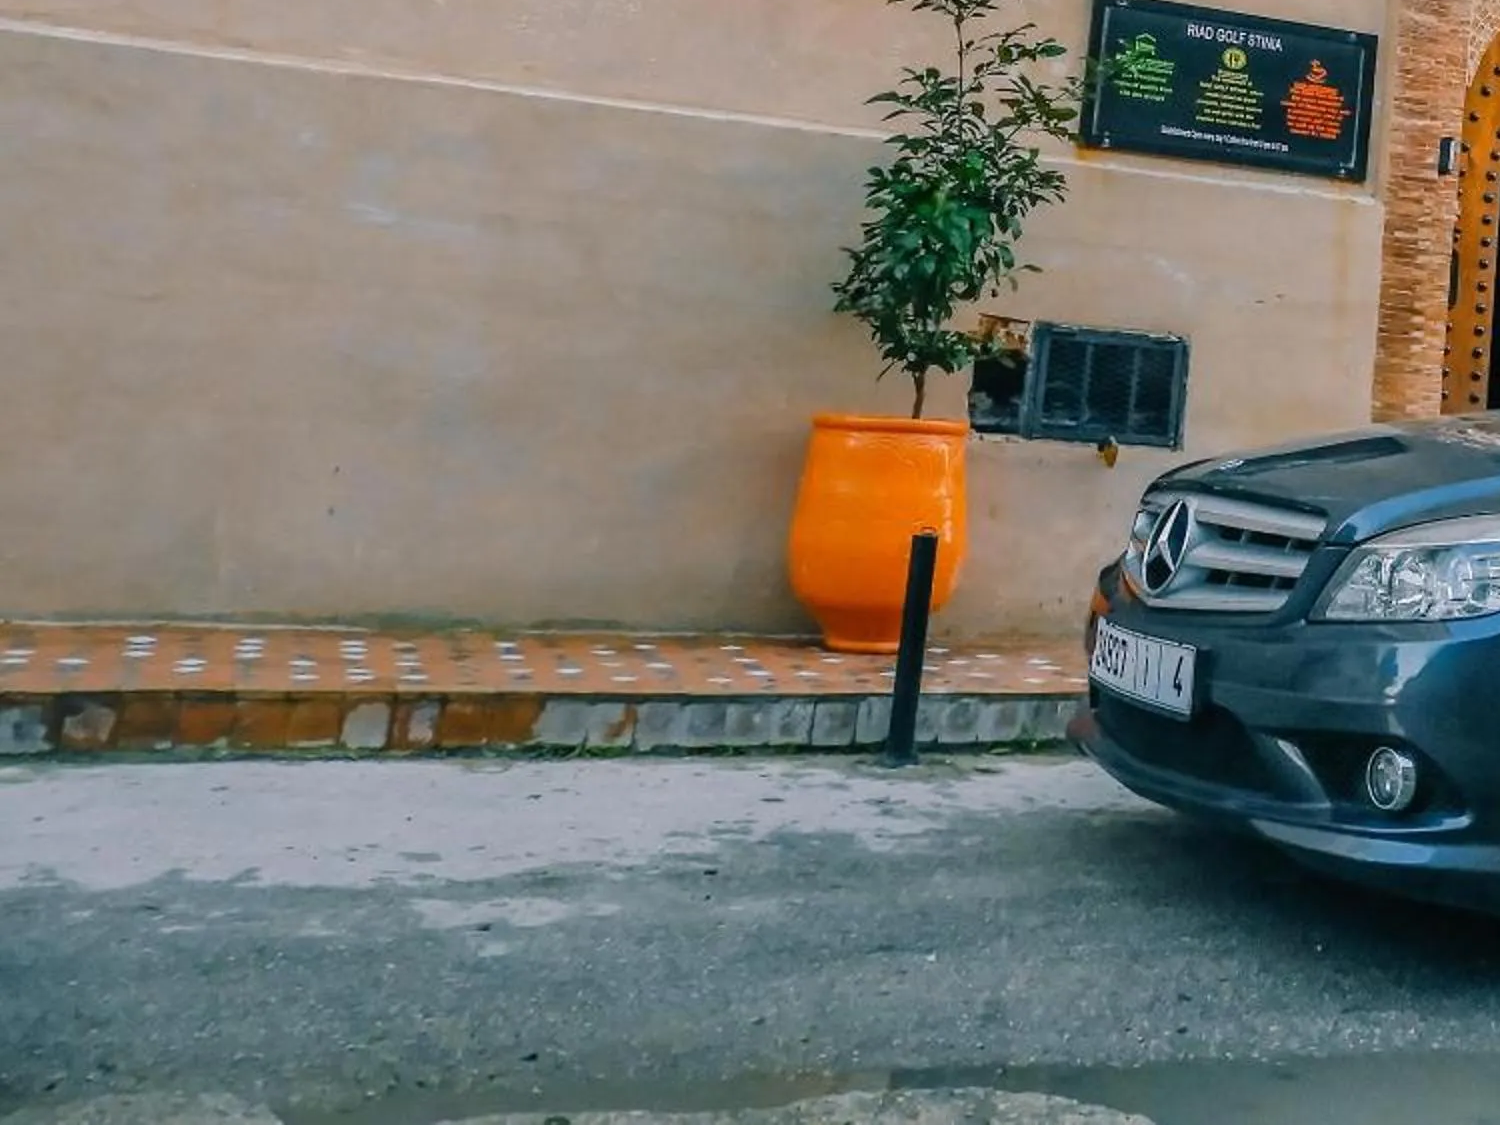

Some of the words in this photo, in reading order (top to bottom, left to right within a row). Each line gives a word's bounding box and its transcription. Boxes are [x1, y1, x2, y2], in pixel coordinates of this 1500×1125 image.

[1187, 24, 1214, 40] RIAD
[1216, 28, 1247, 44] GOLF
[1173, 655, 1183, 697] 4
